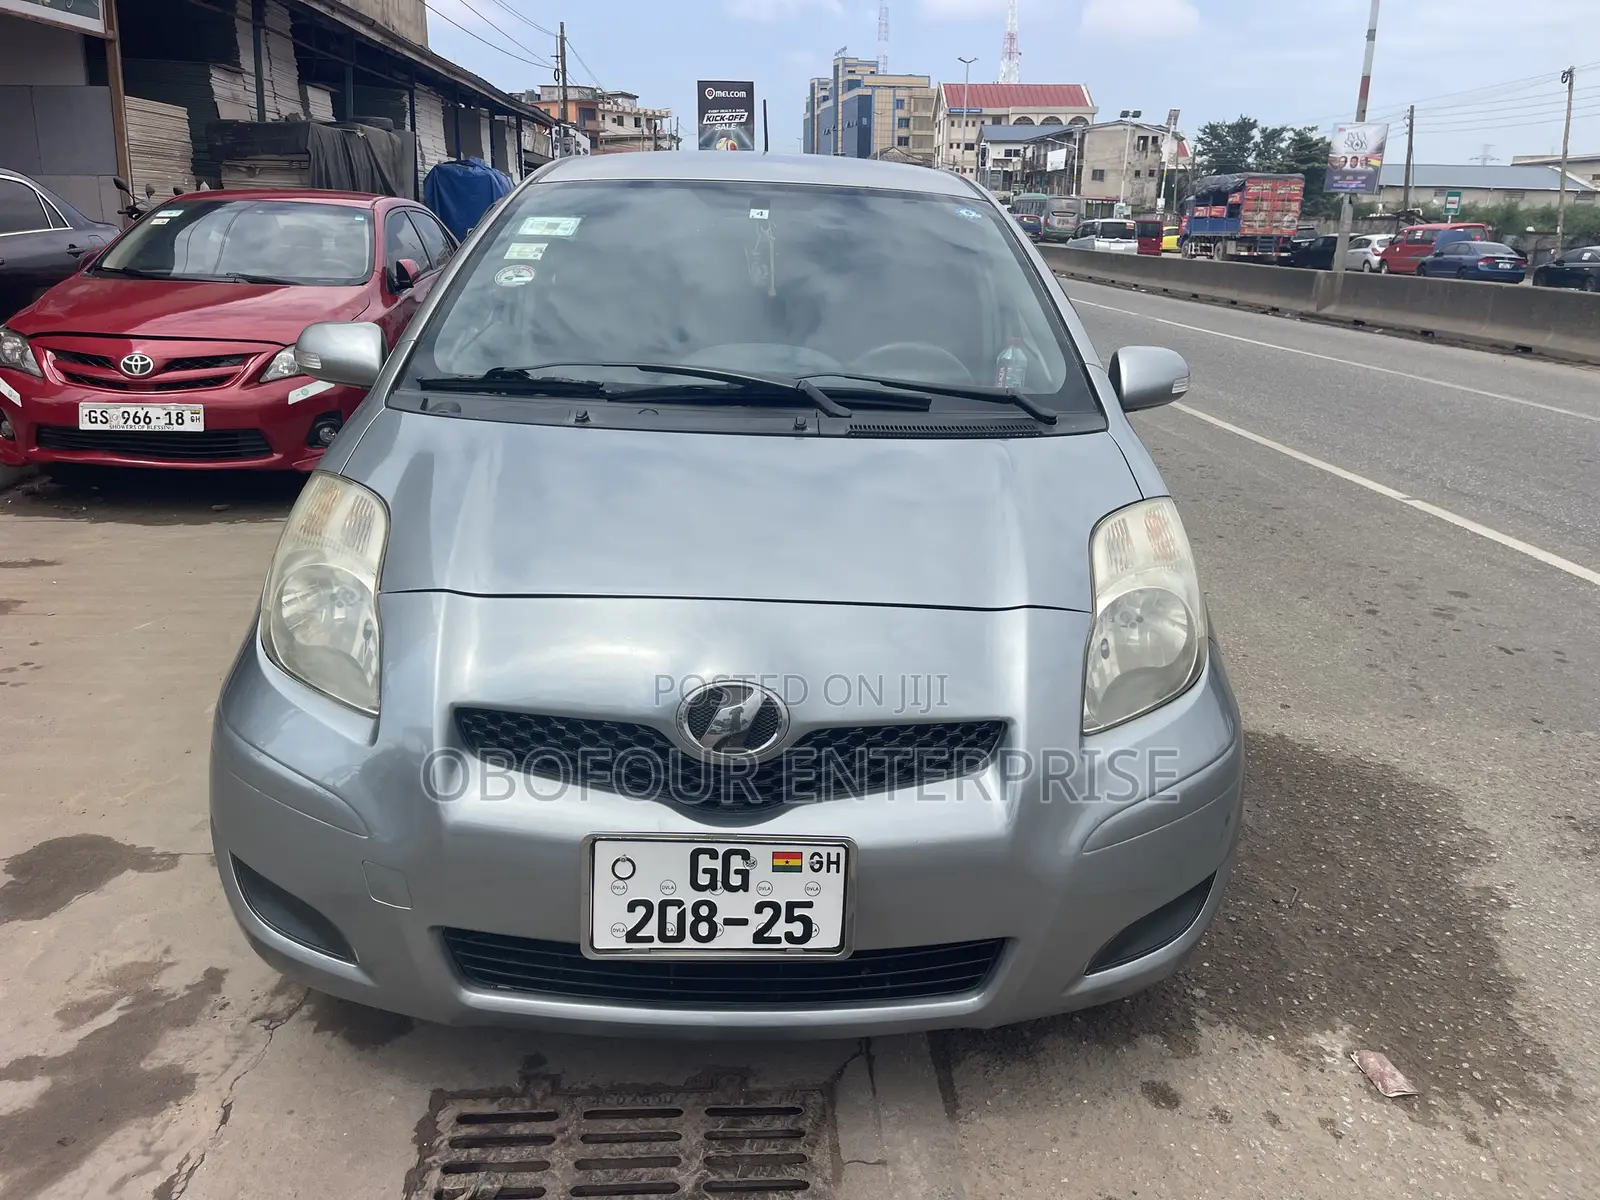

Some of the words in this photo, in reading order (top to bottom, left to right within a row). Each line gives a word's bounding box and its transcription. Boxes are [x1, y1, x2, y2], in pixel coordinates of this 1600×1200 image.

[715, 90, 747, 98] MELCOM
[705, 114, 746, 122] KICK-OFF
[88, 410, 109, 424] GS
[190, 415, 200, 423] GH
[690, 847, 750, 893] GG
[809, 852, 840, 874] GH
[625, 898, 814, 945] 208-25
